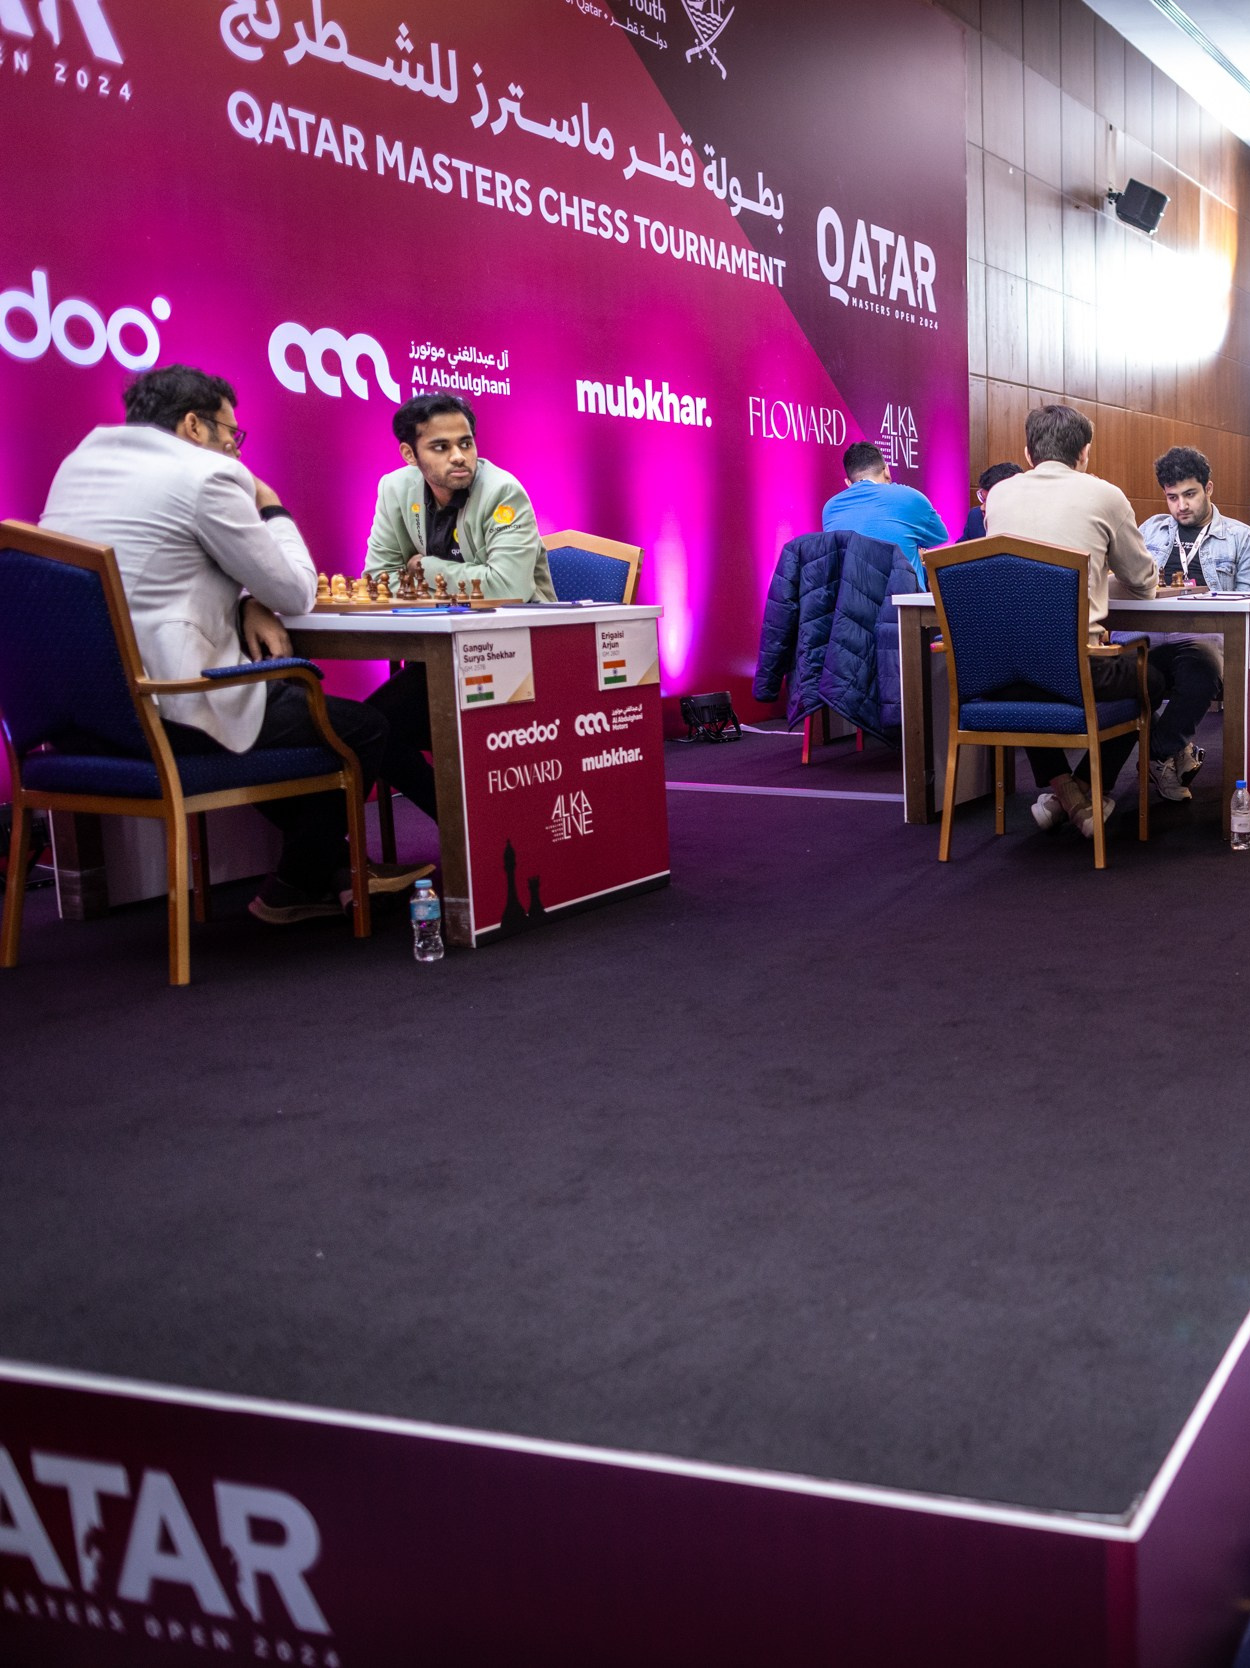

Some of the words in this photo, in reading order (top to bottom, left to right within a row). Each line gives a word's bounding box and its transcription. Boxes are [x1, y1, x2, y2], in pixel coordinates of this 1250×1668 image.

[629, 0, 666, 23] outh
[55, 62, 131, 101] 2024
[471, 62, 615, 160] ماسترز
[623, 132, 696, 189] قطر
[227, 91, 368, 170] QATAR
[376, 135, 532, 216] MASTERS
[539, 187, 630, 244] CHESS
[634, 215, 786, 288] TOURNAMENT
[703, 143, 785, 235] بطولة
[816, 205, 937, 313] QATAR
[851, 297, 890, 316] MASTERS
[895, 309, 915, 323] OPEN
[919, 316, 939, 330] 2024
[409, 341, 446, 362] موتورز
[447, 346, 495, 369] عبدالغني
[411, 365, 428, 385] Al
[430, 368, 511, 396] Abdulghani
[749, 396, 847, 446] FLOWARD
[880, 402, 919, 439] ALKA
[890, 435, 919, 469] LINE
[463, 642, 493, 653] Ganguly
[463, 655, 485, 664] Surya
[487, 651, 516, 661] Shekhar
[602, 641, 619, 650] Arjun
[488, 759, 562, 794] FLOWARD
[551, 790, 592, 820] ALKA
